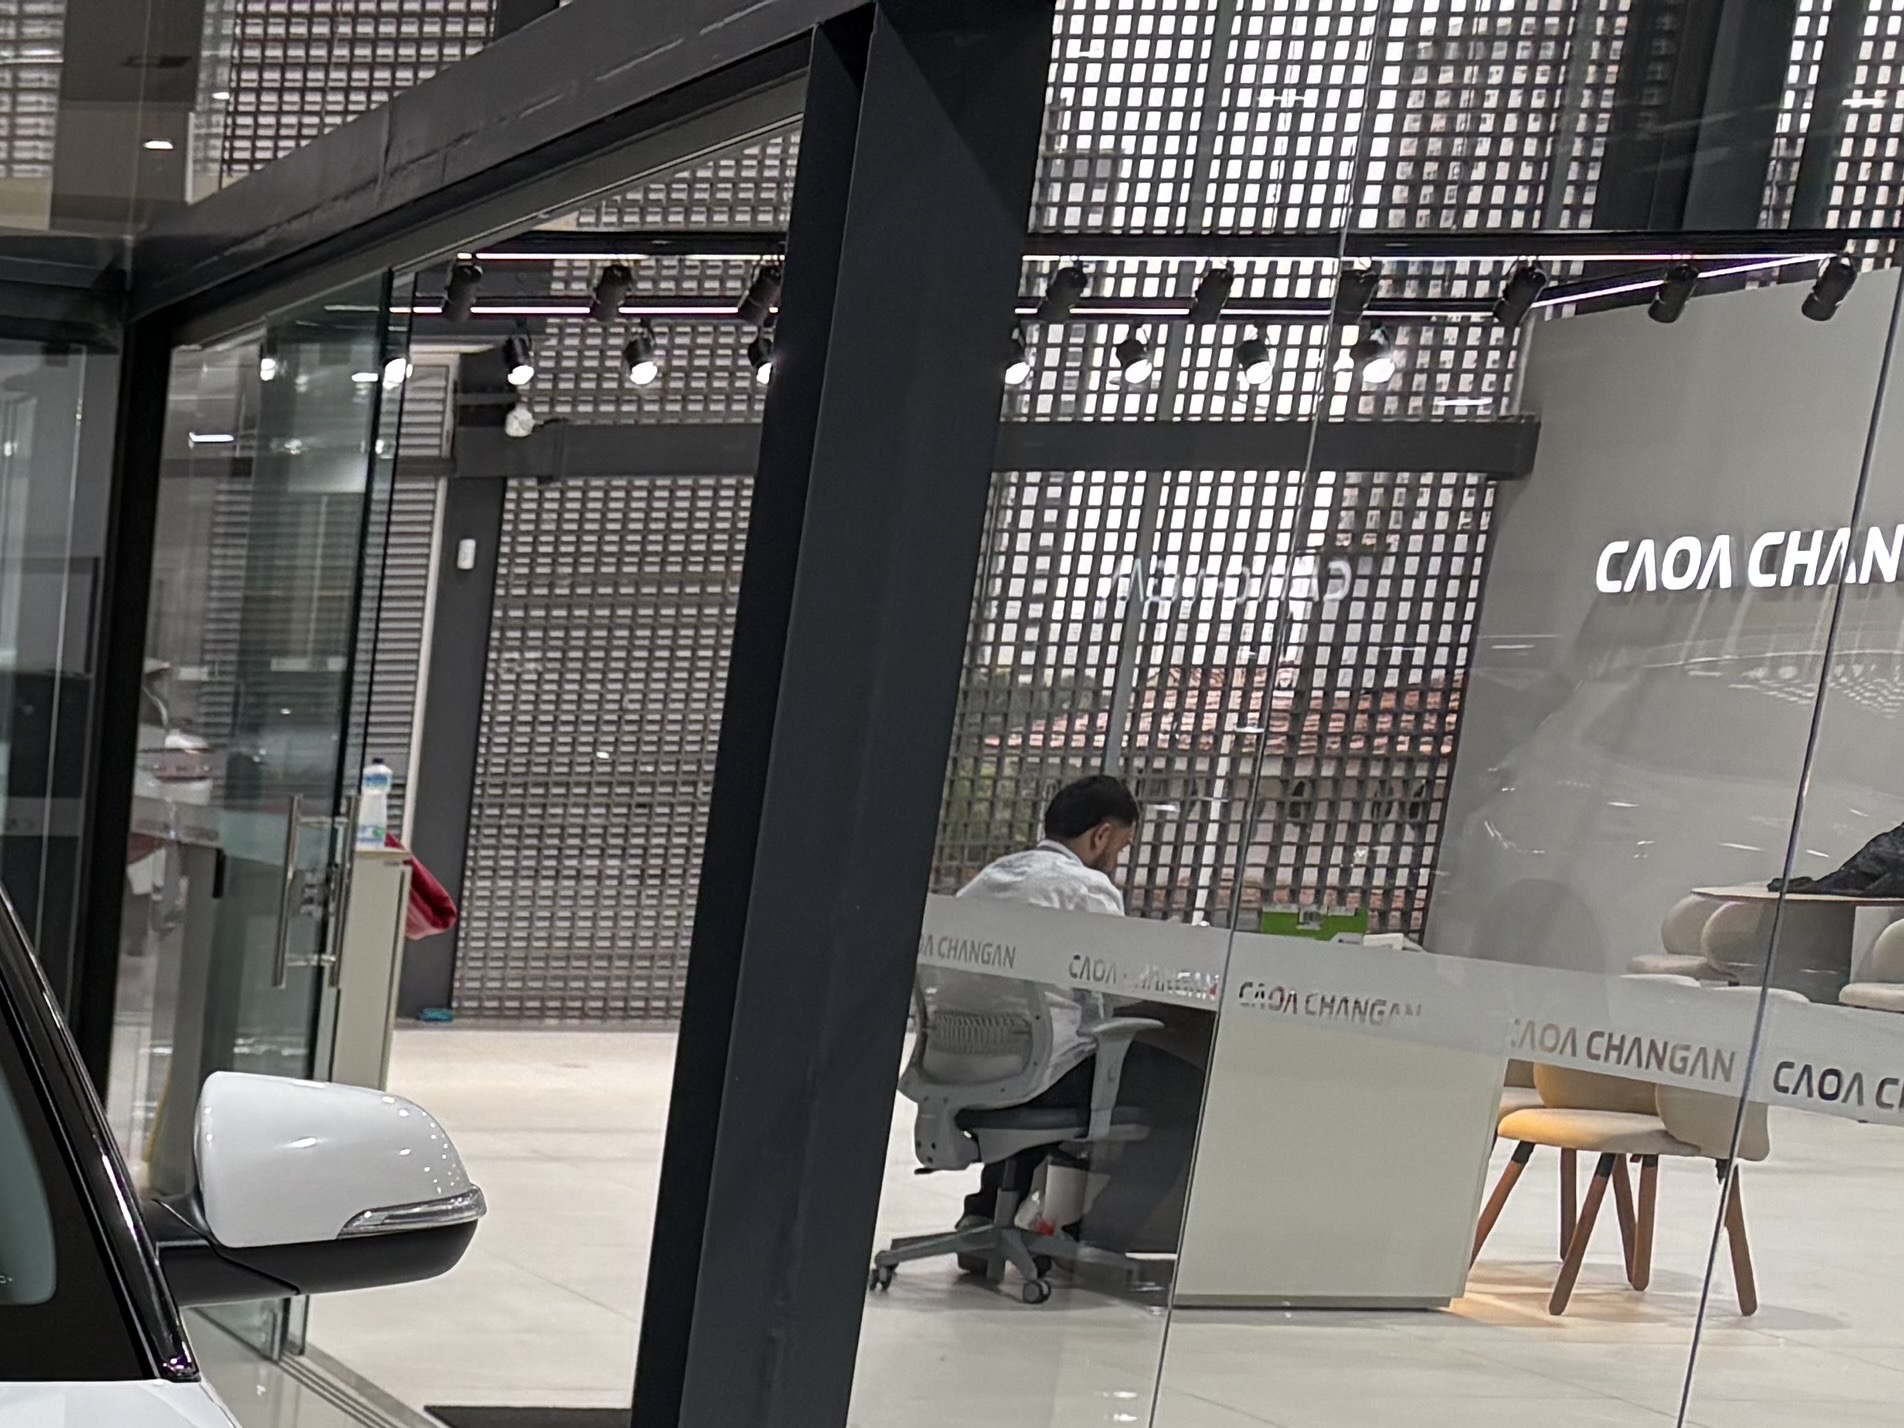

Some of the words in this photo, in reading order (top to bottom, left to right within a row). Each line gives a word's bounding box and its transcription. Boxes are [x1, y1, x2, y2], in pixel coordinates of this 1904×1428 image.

[1595, 534, 1732, 593] CAOA
[936, 936, 1017, 970] CHANGAN
[1585, 1030, 1737, 1083] CHANGAN
[1772, 1061, 1865, 1108] CAOA
